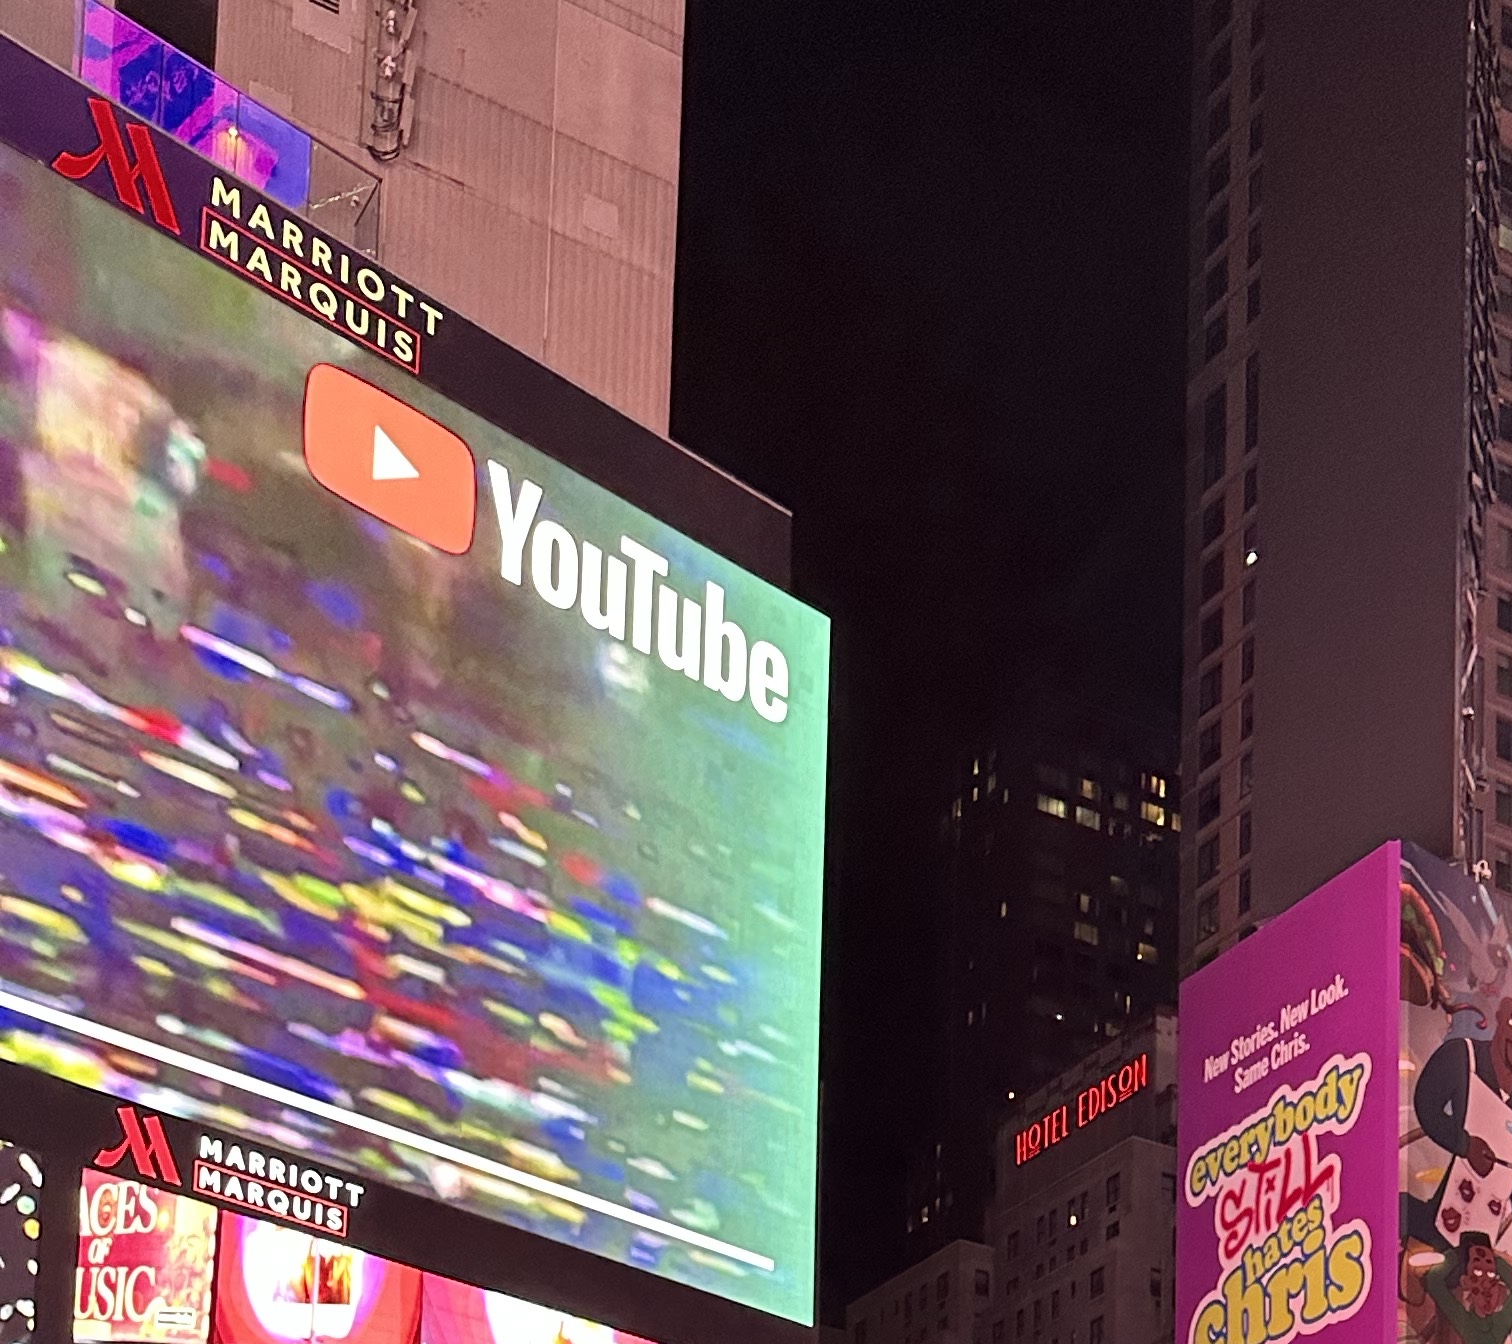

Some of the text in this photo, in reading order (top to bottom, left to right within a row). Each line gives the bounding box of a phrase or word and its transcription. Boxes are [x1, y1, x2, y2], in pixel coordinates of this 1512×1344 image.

[208, 221, 416, 364] MARQUIS
[210, 177, 444, 336] MARRIOTT
[487, 459, 790, 725] YouTube
[1203, 974, 1349, 1083] New Stories. New Look.
[1234, 1032, 1311, 1094] Same Chris.
[1016, 1054, 1148, 1166] HOTEL EDISON
[1190, 1063, 1364, 1198] everybody
[198, 1167, 345, 1232] MARQUIS
[199, 1136, 365, 1208] MARRIOTT
[1241, 1193, 1325, 1286] hates
